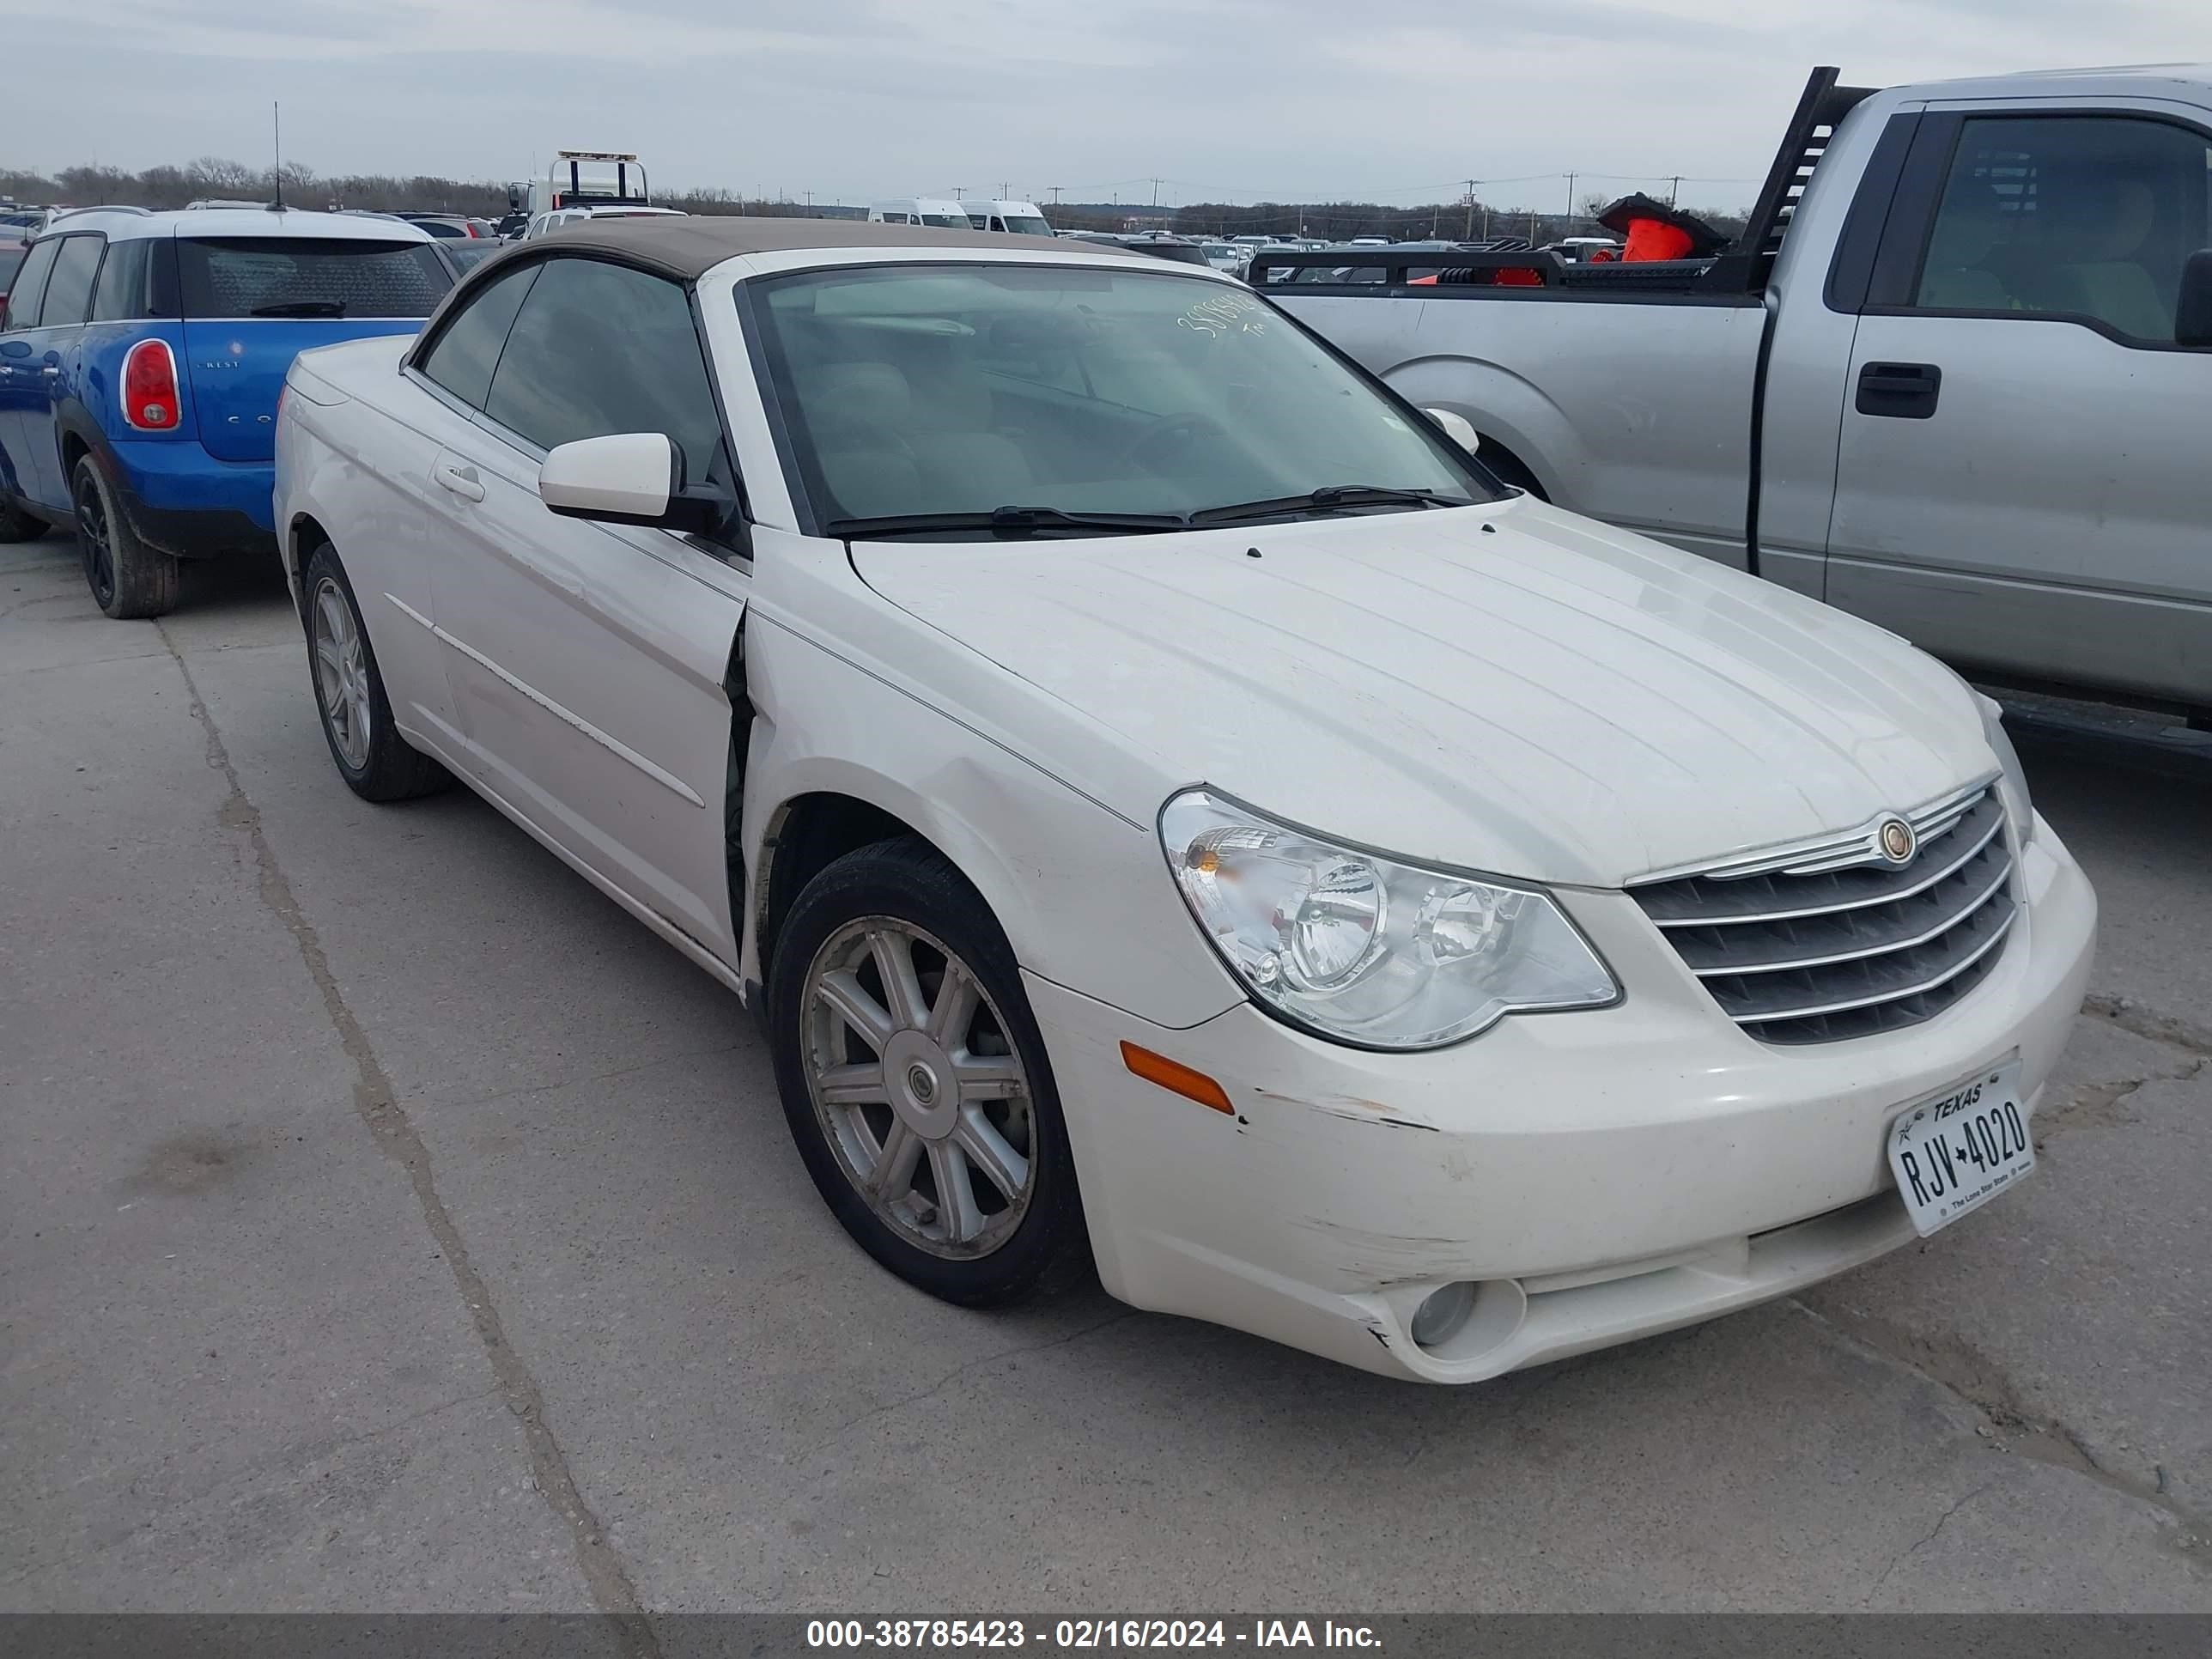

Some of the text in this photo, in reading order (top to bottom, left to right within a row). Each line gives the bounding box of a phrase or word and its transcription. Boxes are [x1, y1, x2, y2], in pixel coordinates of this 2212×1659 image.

[1462, 196, 1473, 205] 10
[1934, 1083, 1982, 1122] TEXAS
[1951, 1174, 2008, 1209] The Lone Star State
